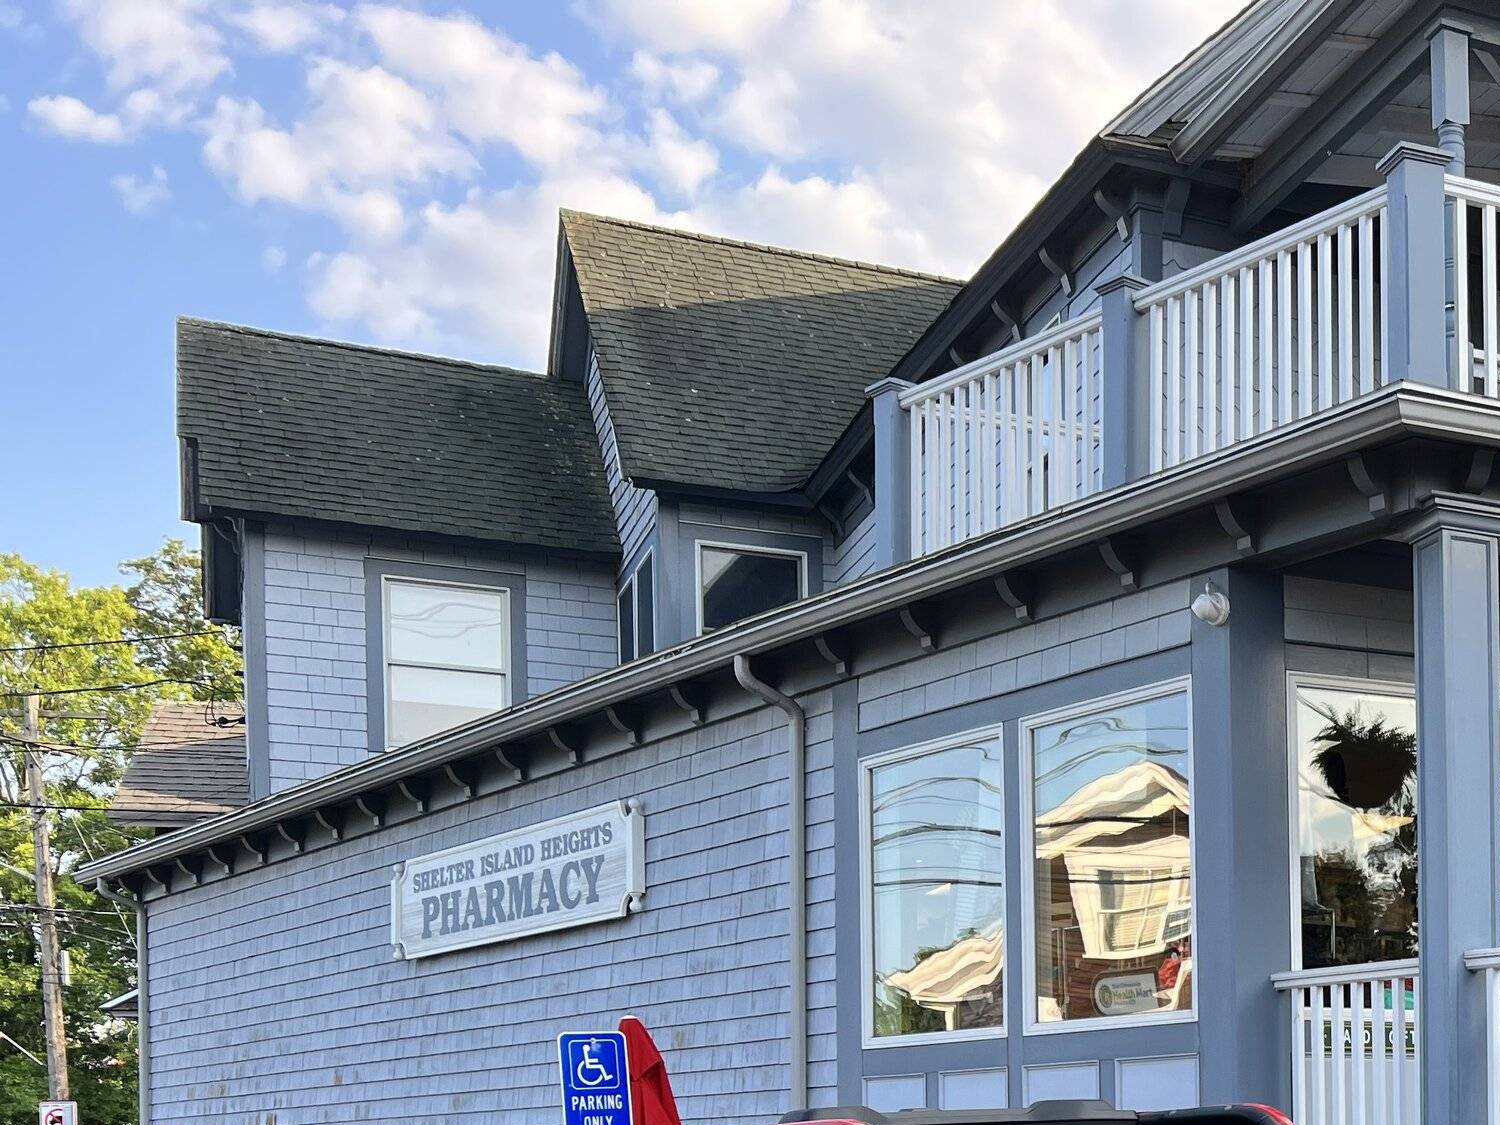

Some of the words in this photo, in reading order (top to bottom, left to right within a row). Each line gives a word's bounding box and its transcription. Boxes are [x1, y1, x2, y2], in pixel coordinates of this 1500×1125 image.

[413, 859, 475, 893] SHELTER
[480, 844, 535, 877] ISLAND
[540, 822, 613, 861] HEIGHTS
[421, 855, 605, 939] PHARMACY
[571, 1094, 623, 1111] PARKING
